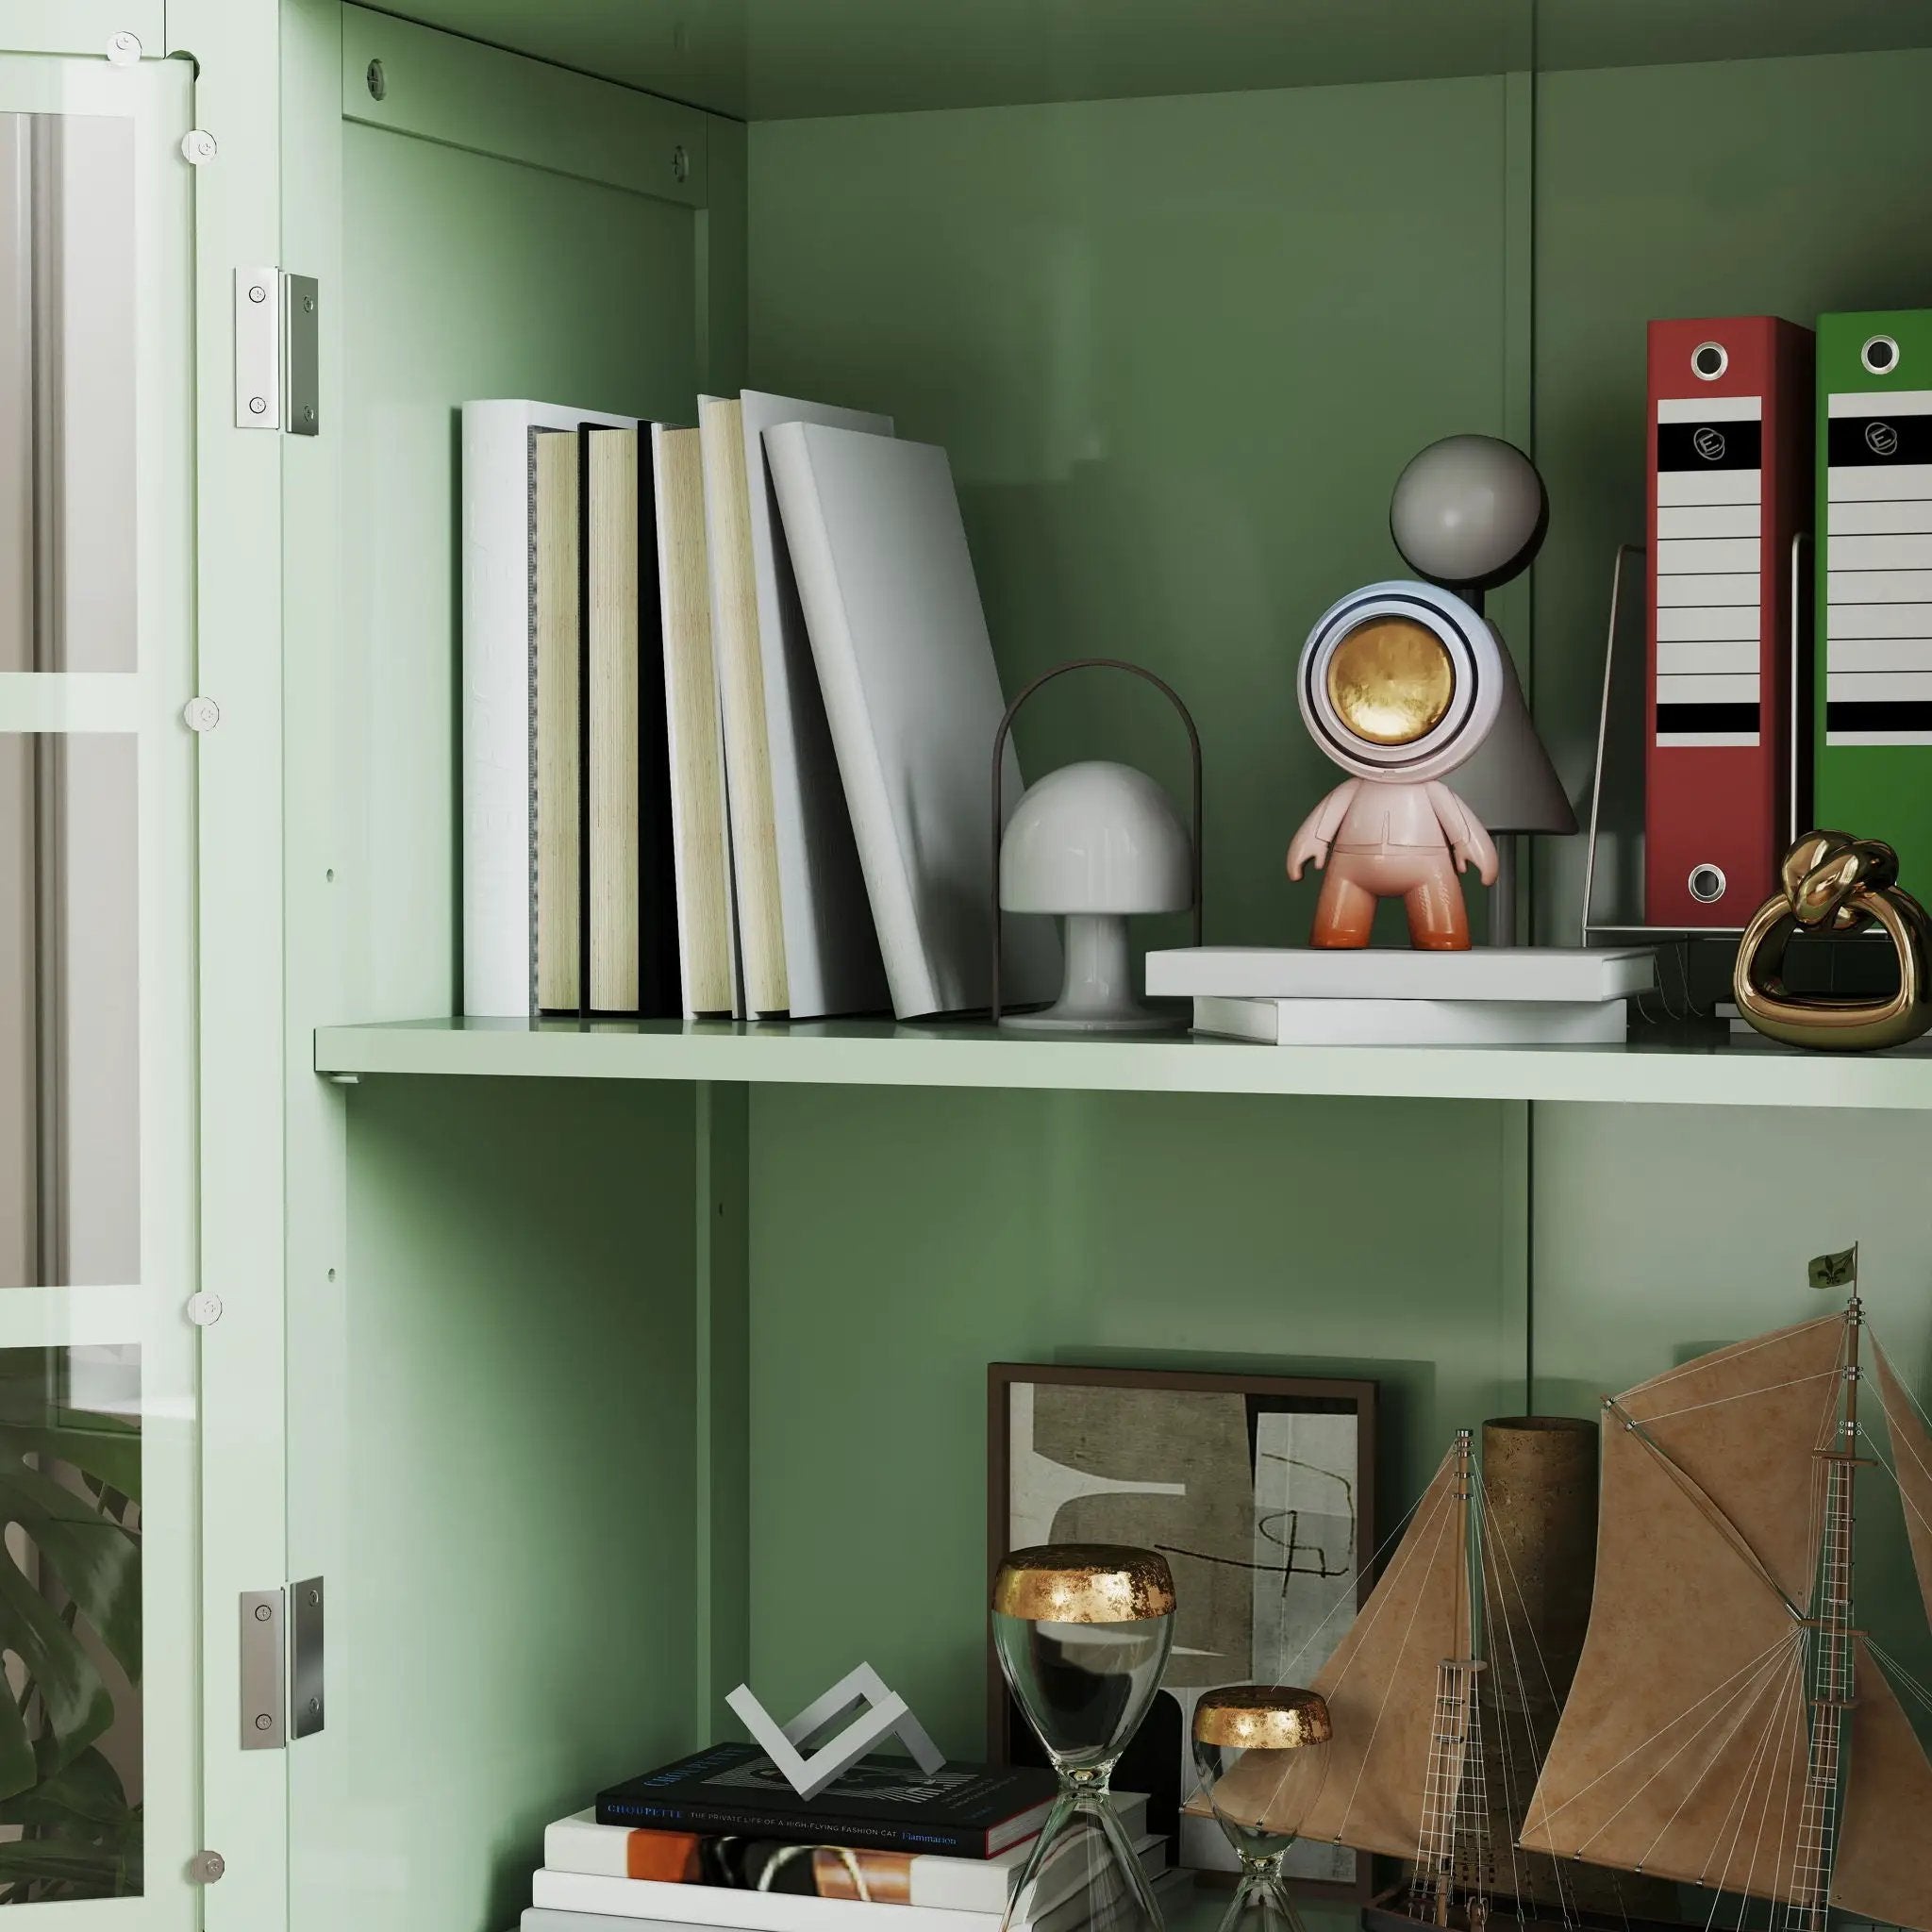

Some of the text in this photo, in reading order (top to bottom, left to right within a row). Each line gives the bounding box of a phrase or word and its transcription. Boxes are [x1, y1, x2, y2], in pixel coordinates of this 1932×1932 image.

[691, 1811, 705, 1820] THE
[708, 1812, 741, 1823] PRIVATE
[743, 1817, 762, 1825] LIFE
[763, 1818, 775, 1826] OF
[786, 1821, 840, 1832] HIGH-FLYING
[841, 1826, 878, 1836] FASHION
[901, 1831, 958, 1845] Flammarion
